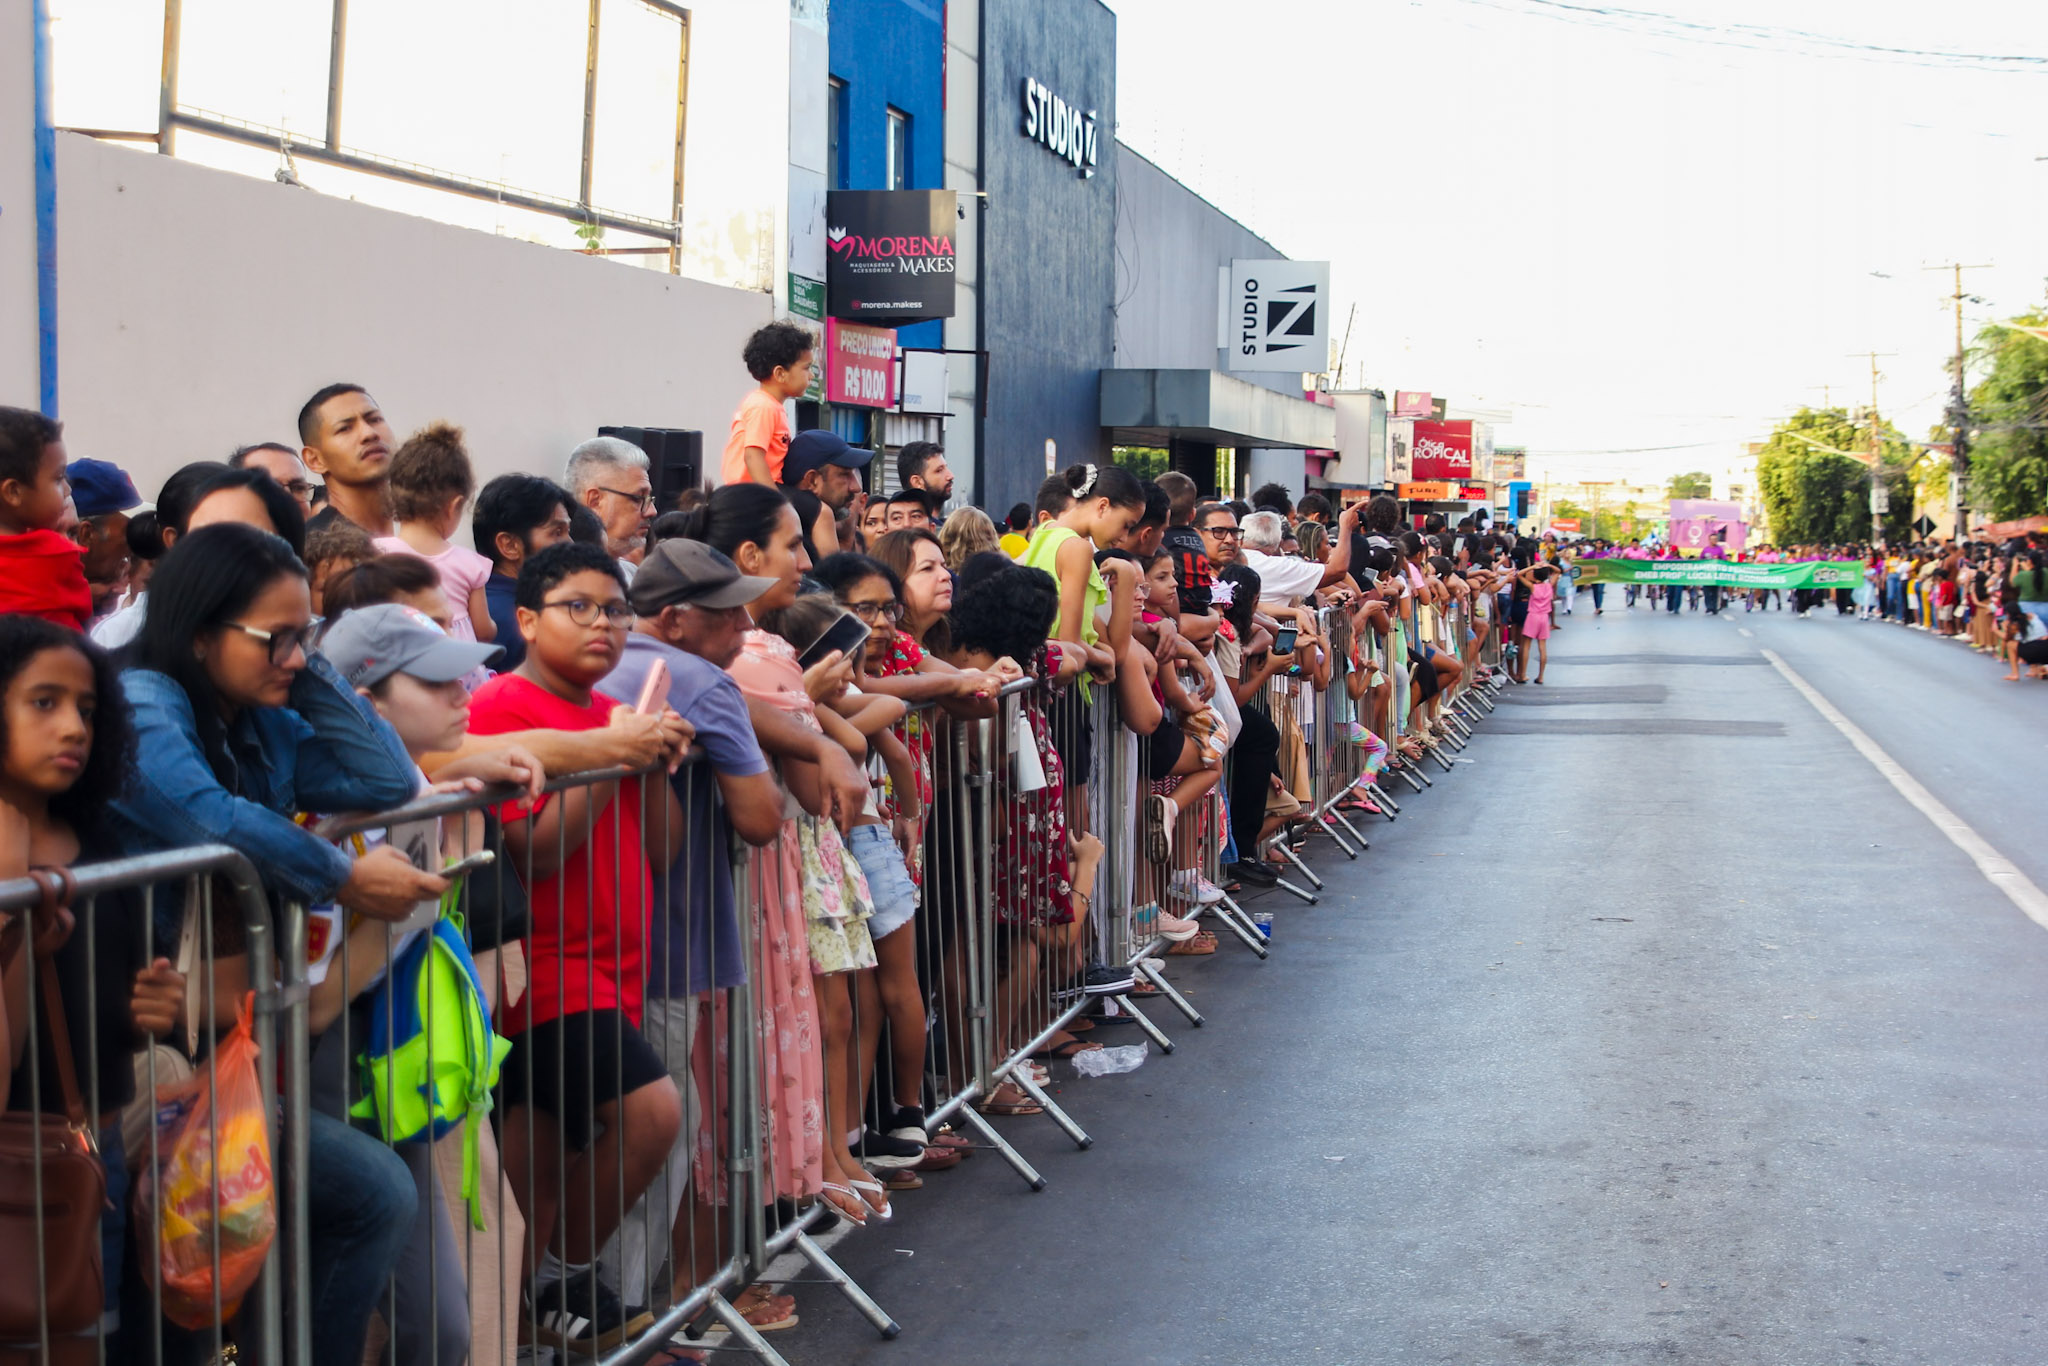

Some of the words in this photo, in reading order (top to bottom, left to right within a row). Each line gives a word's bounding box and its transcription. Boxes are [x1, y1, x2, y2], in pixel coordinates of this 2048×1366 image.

[1026, 77, 1083, 168] STUDIO
[855, 236, 955, 260] MORENA
[898, 256, 955, 276] MAKES
[1242, 278, 1259, 356] STUDIO
[840, 329, 868, 359] PREÇO
[844, 364, 861, 401] R$
[861, 368, 887, 403] 10,00
